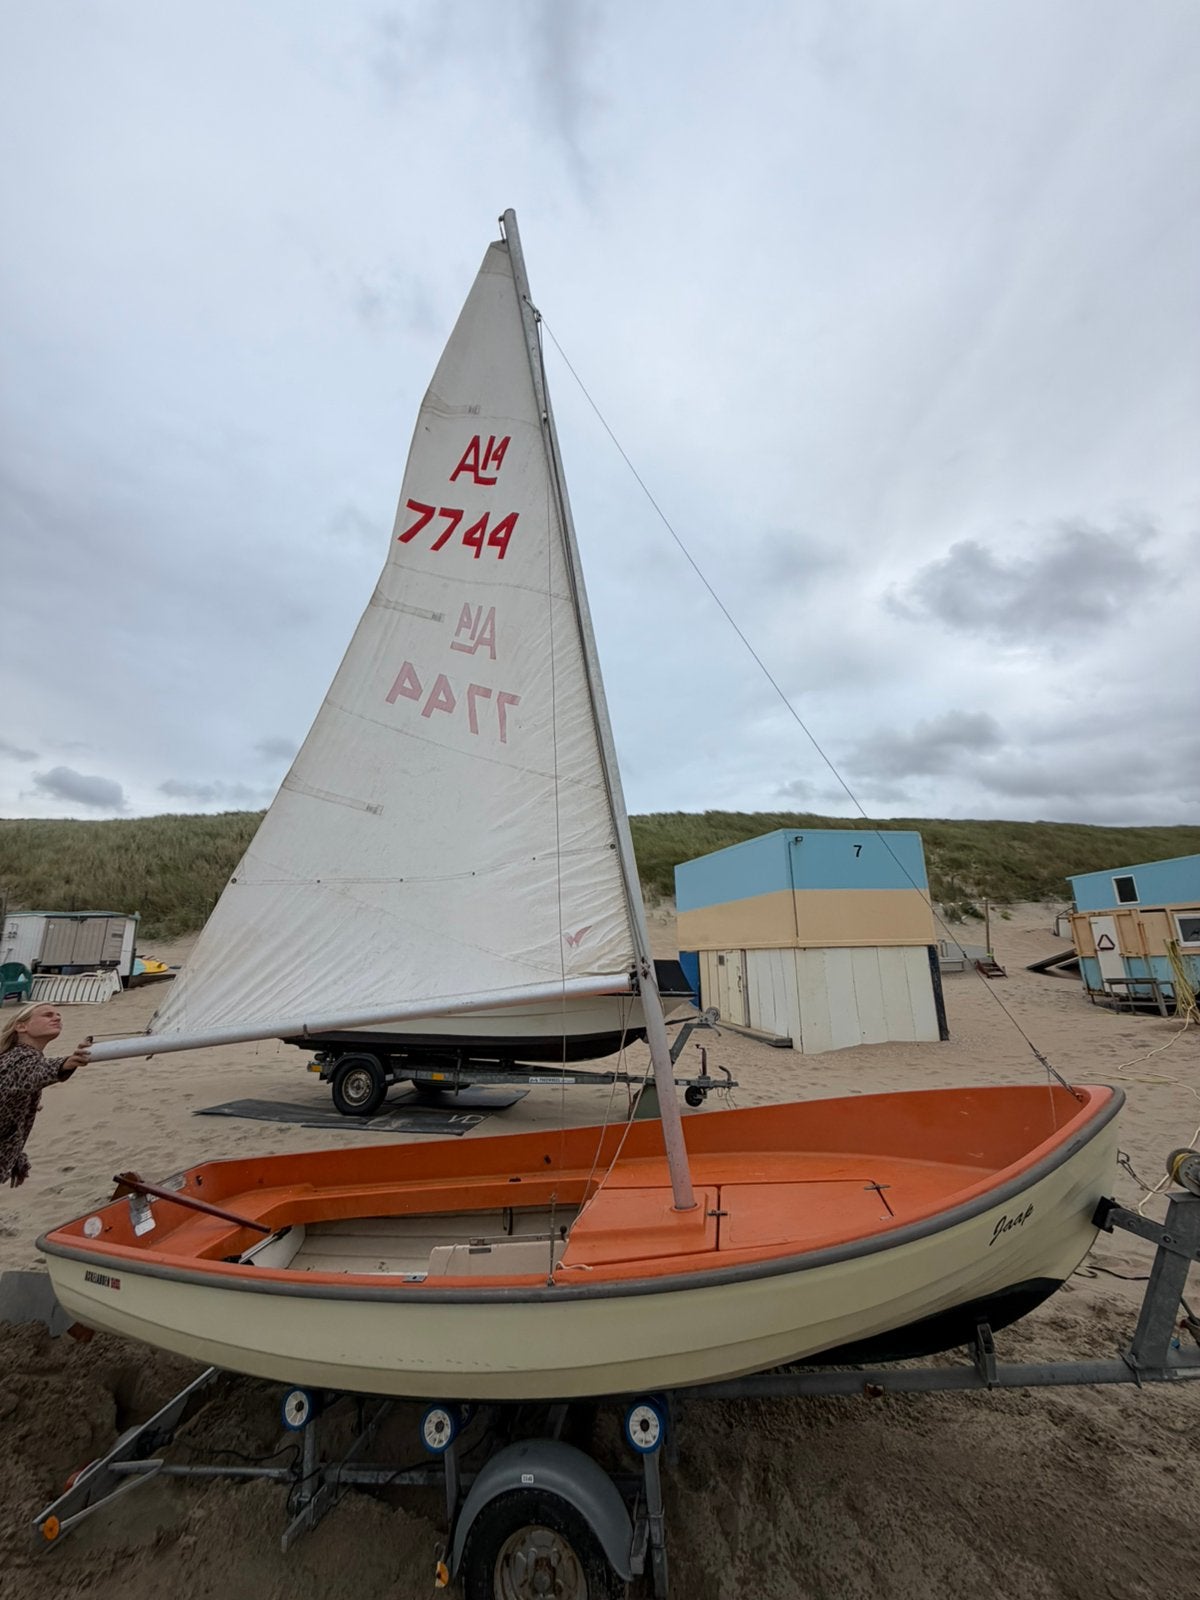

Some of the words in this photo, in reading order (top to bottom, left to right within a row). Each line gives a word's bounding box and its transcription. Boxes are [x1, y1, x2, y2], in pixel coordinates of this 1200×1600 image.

[397, 498, 520, 560] 7744
[853, 844, 862, 858] 7
[988, 1202, 1034, 1247] Jaap
